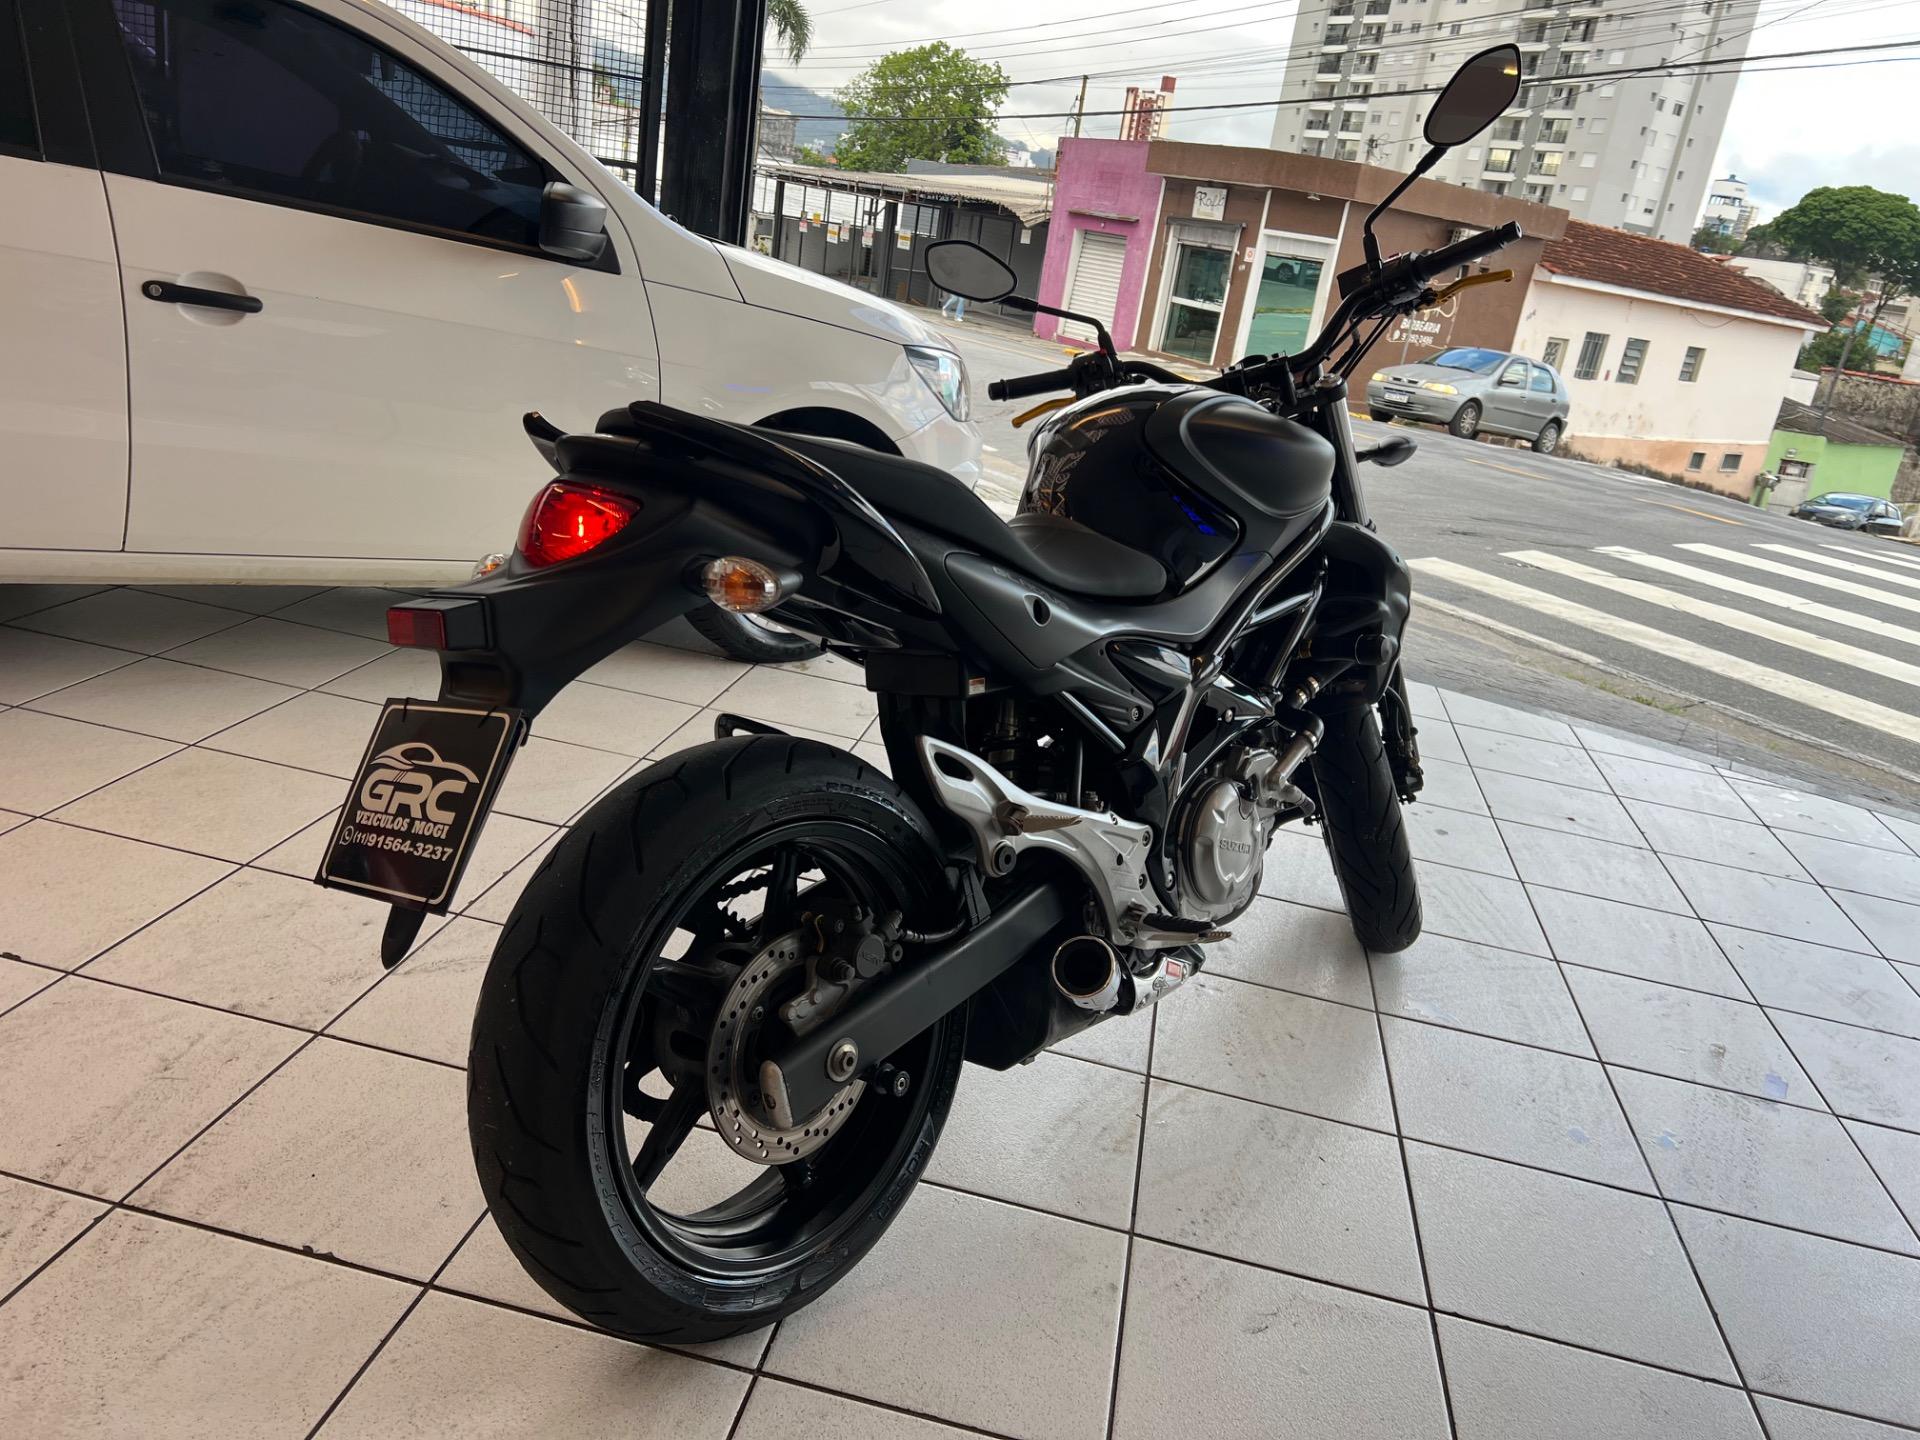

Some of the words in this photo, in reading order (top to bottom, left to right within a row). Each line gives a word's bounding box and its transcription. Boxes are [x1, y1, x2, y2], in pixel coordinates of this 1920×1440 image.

[361, 768, 467, 823] GRC
[355, 810, 410, 832] VEICULOS
[412, 820, 450, 839] MOGI
[1219, 838, 1251, 854] SUZUKI
